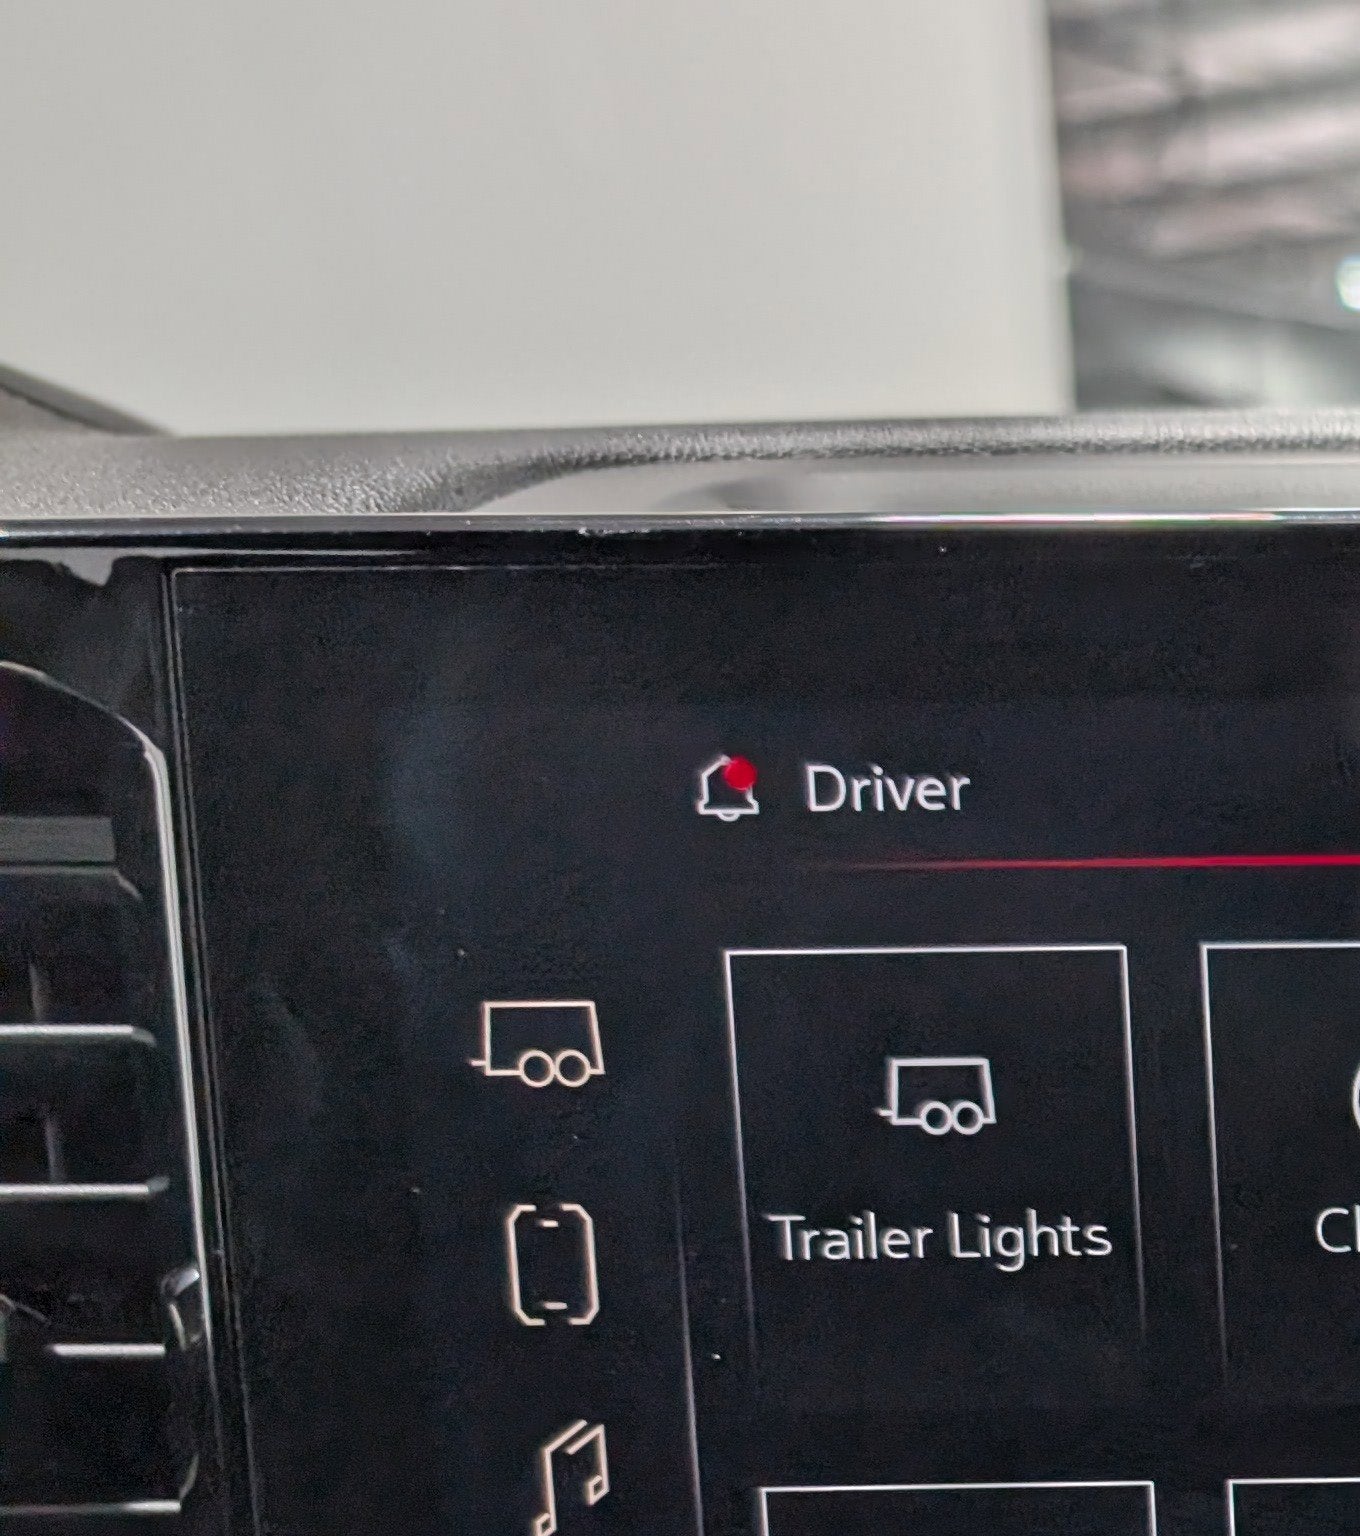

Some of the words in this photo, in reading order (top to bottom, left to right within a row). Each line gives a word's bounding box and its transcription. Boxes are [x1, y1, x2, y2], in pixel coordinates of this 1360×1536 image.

[804, 762, 971, 812] Driver
[766, 1210, 934, 1261] Trailer
[949, 1207, 1113, 1272] Lights
